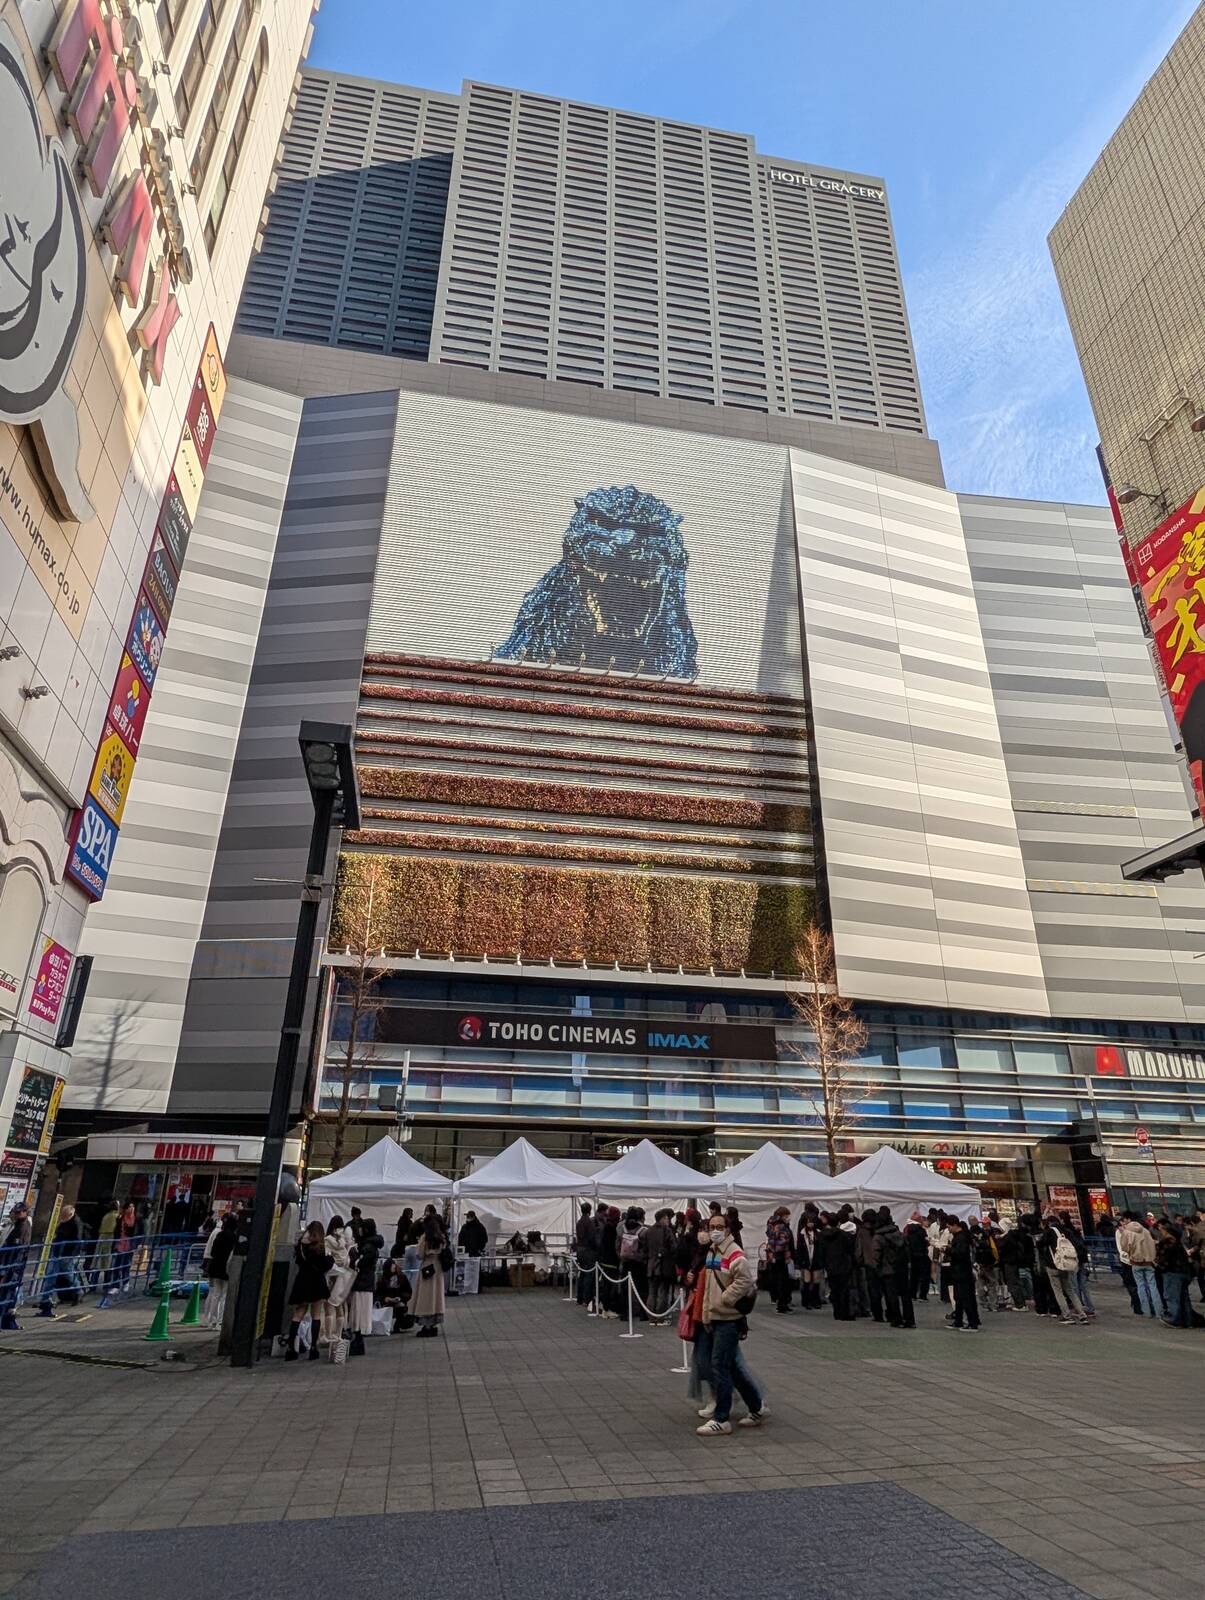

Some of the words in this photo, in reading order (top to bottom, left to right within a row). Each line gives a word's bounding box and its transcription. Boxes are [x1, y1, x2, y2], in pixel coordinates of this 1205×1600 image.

[769, 169, 817, 188] HOTEL
[819, 179, 885, 200] GRACERY
[1153, 517, 1186, 549] KODANSHA
[154, 551, 174, 601] BAGUS
[112, 703, 139, 747] 卓球バー
[77, 805, 109, 873] SPA
[488, 1021, 544, 1041] TOHO
[548, 1024, 637, 1045] CINEMAS
[648, 1032, 711, 1050] IMAX
[154, 1143, 216, 1160] MARUHAN
